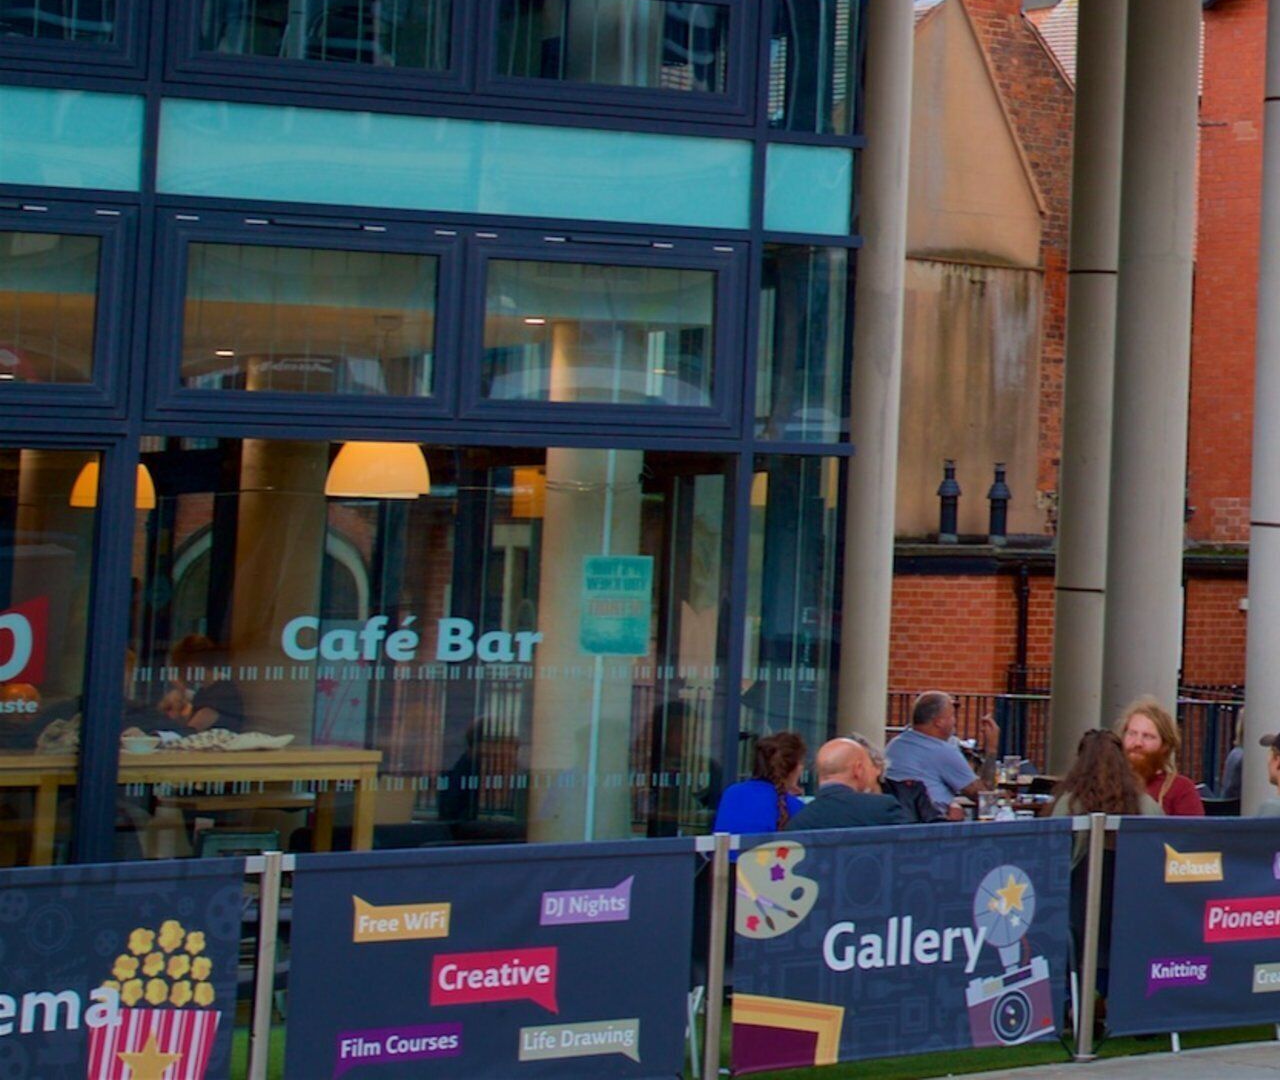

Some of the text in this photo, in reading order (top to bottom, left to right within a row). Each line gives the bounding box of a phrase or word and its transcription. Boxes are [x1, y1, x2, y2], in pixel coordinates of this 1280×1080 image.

[281, 616, 543, 662] Café Bar
[0, 699, 38, 713] ste
[1169, 859, 1220, 875] Relaxed
[544, 895, 626, 917] DJ Nights
[358, 910, 445, 933] Free WiFi
[823, 915, 987, 974] Gallery
[438, 959, 550, 991] Creative
[1151, 961, 1208, 980] Knitting
[341, 1033, 460, 1059] Film Courses
[524, 1025, 634, 1051] Life Drawing
